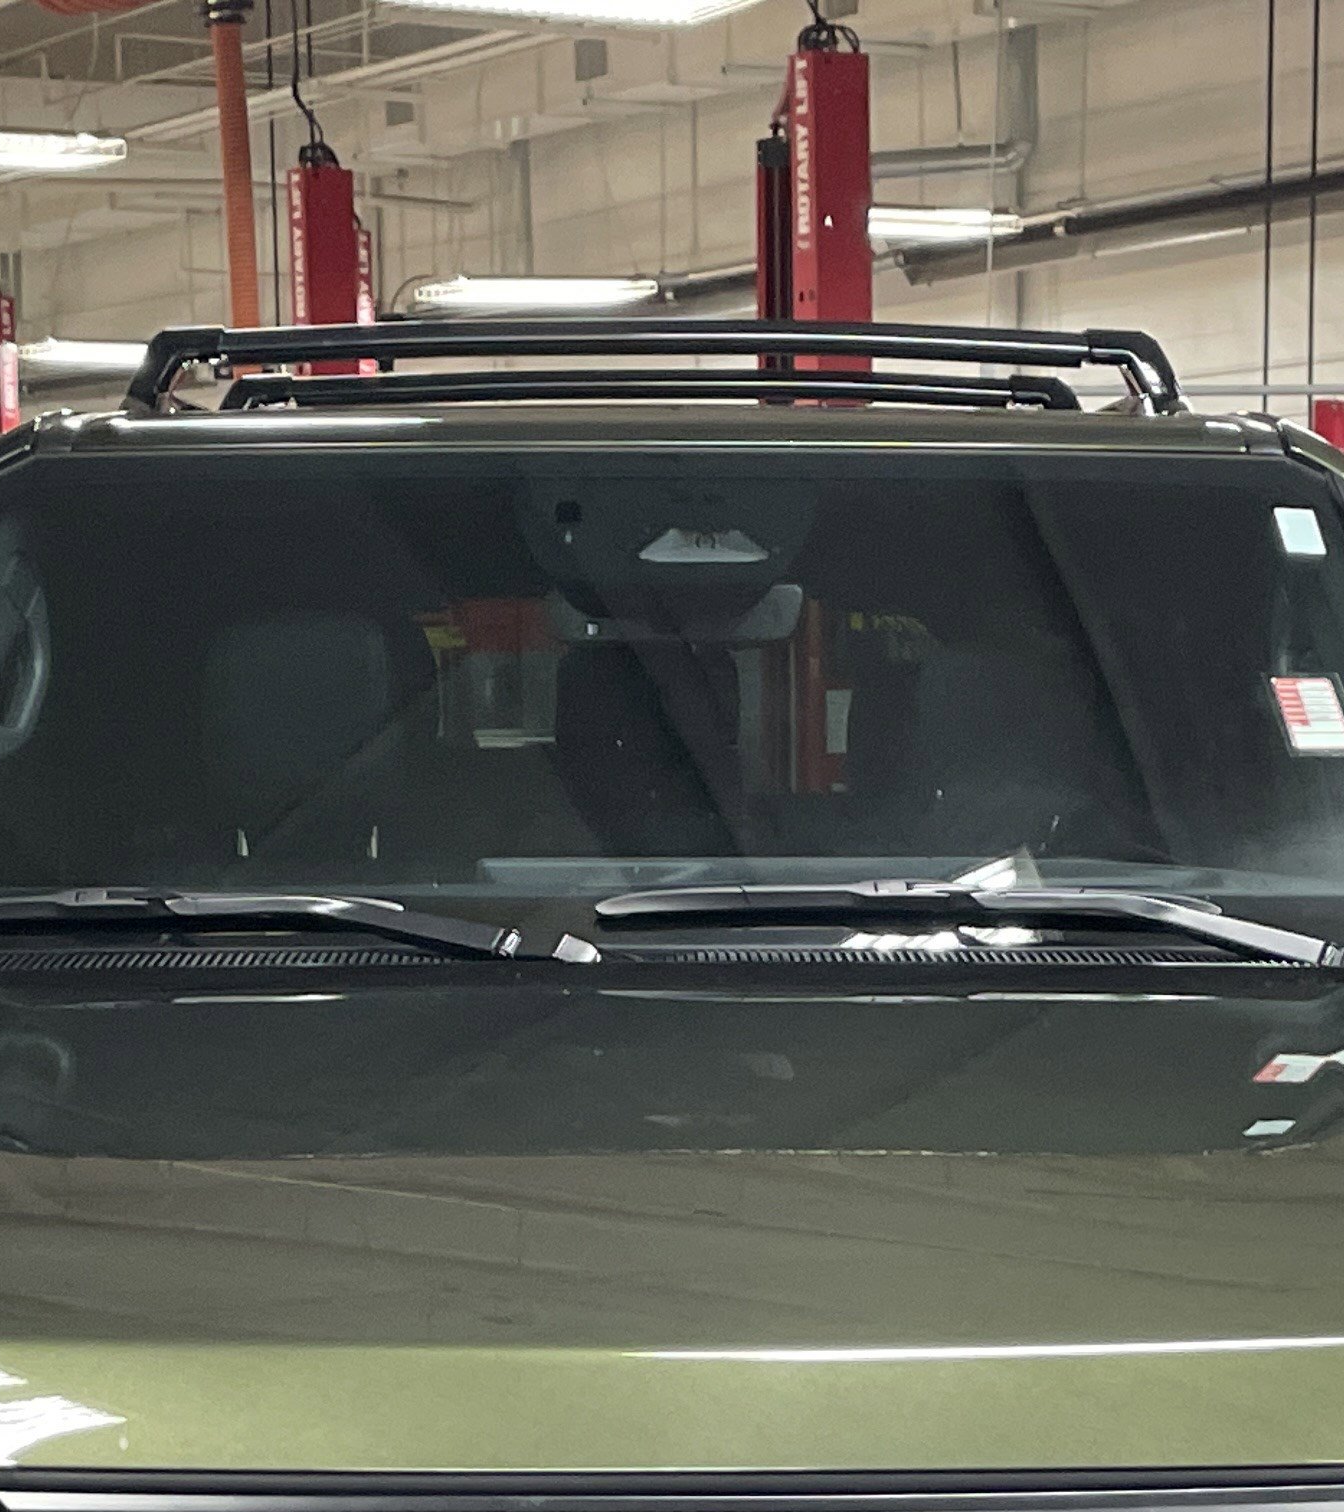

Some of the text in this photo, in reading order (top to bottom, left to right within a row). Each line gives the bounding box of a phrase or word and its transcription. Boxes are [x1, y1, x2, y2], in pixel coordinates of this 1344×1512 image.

[795, 58, 810, 234] ROTARY LIFT
[291, 172, 305, 318] ROTARY LIFT
